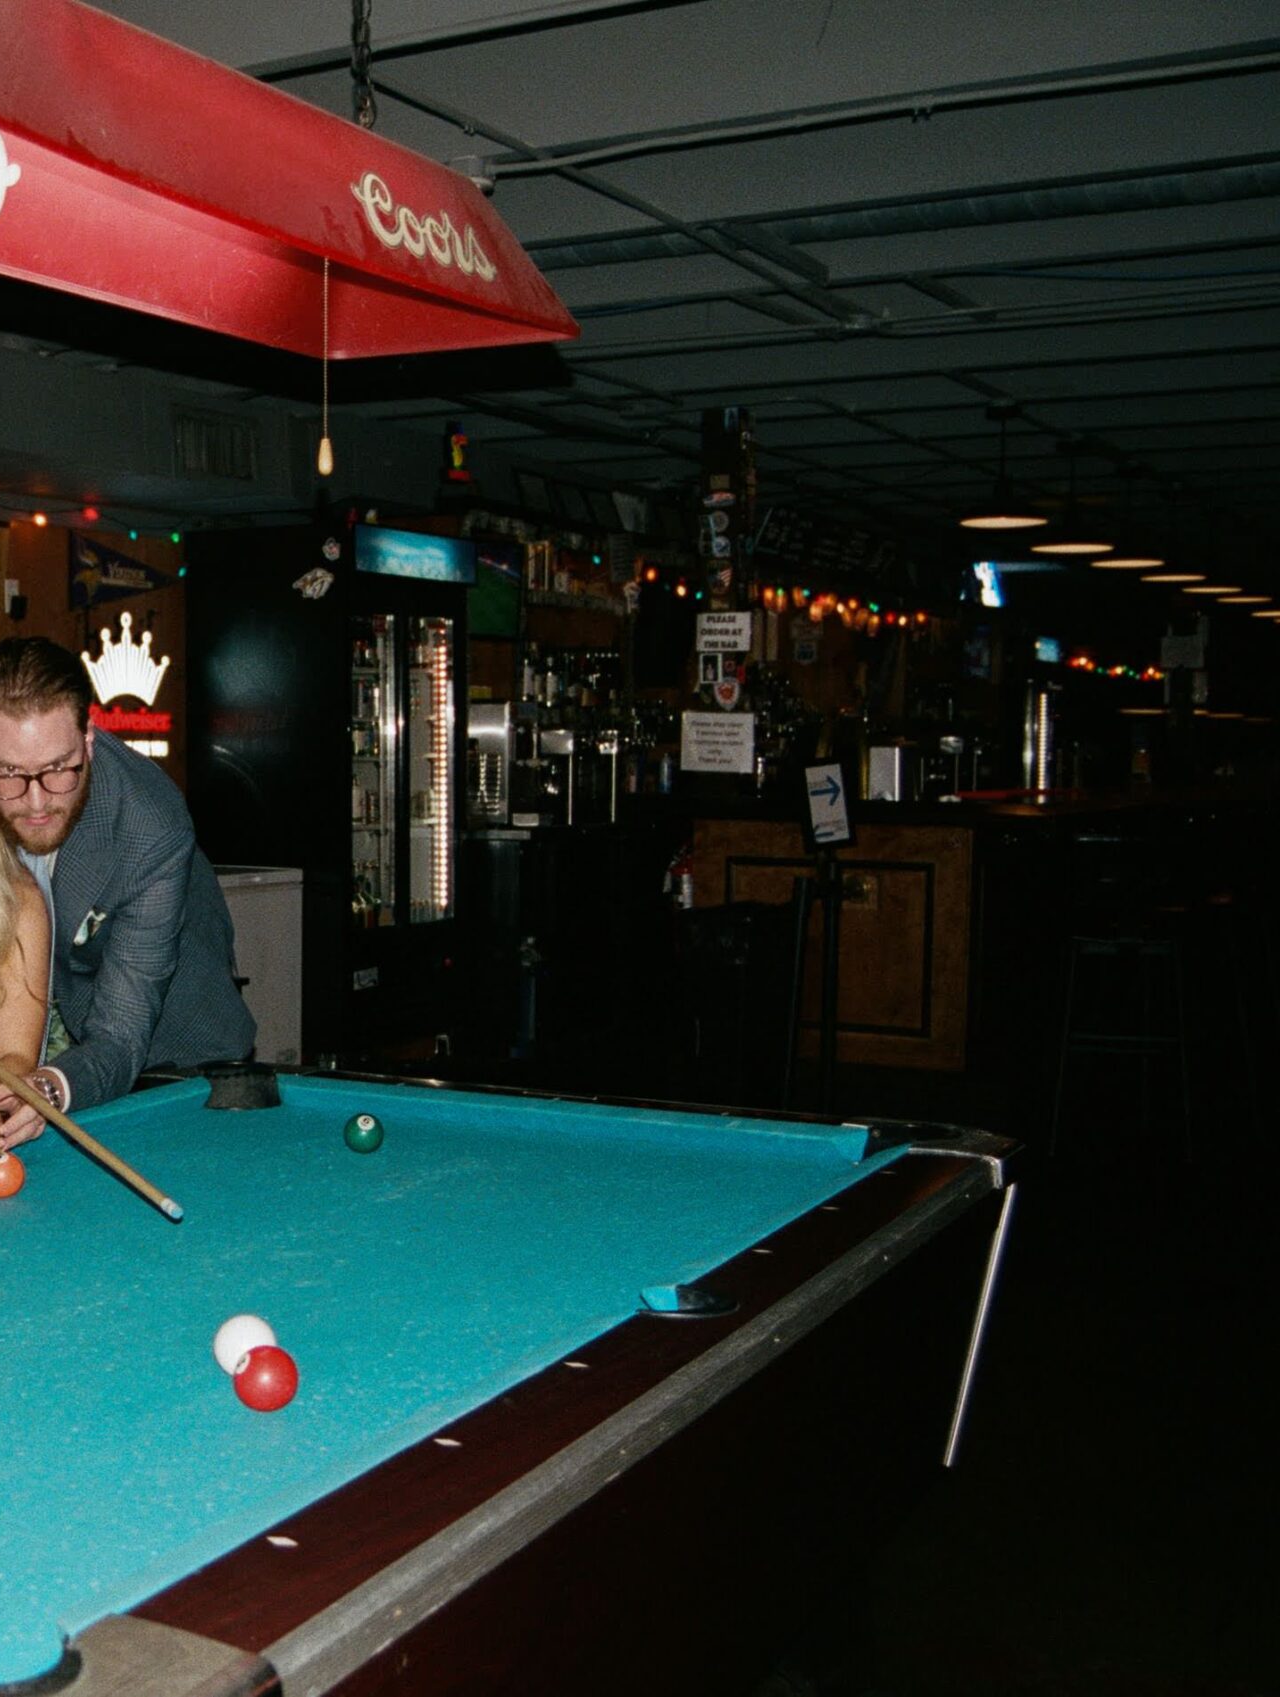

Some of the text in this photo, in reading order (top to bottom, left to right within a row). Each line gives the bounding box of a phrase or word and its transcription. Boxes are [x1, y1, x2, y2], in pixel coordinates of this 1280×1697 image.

[349, 171, 498, 283] Coors
[706, 615, 736, 623] PLEASE
[700, 628, 744, 636] ORDER AT
[704, 640, 738, 649] THE BAR
[89, 703, 173, 734] Budweiser
